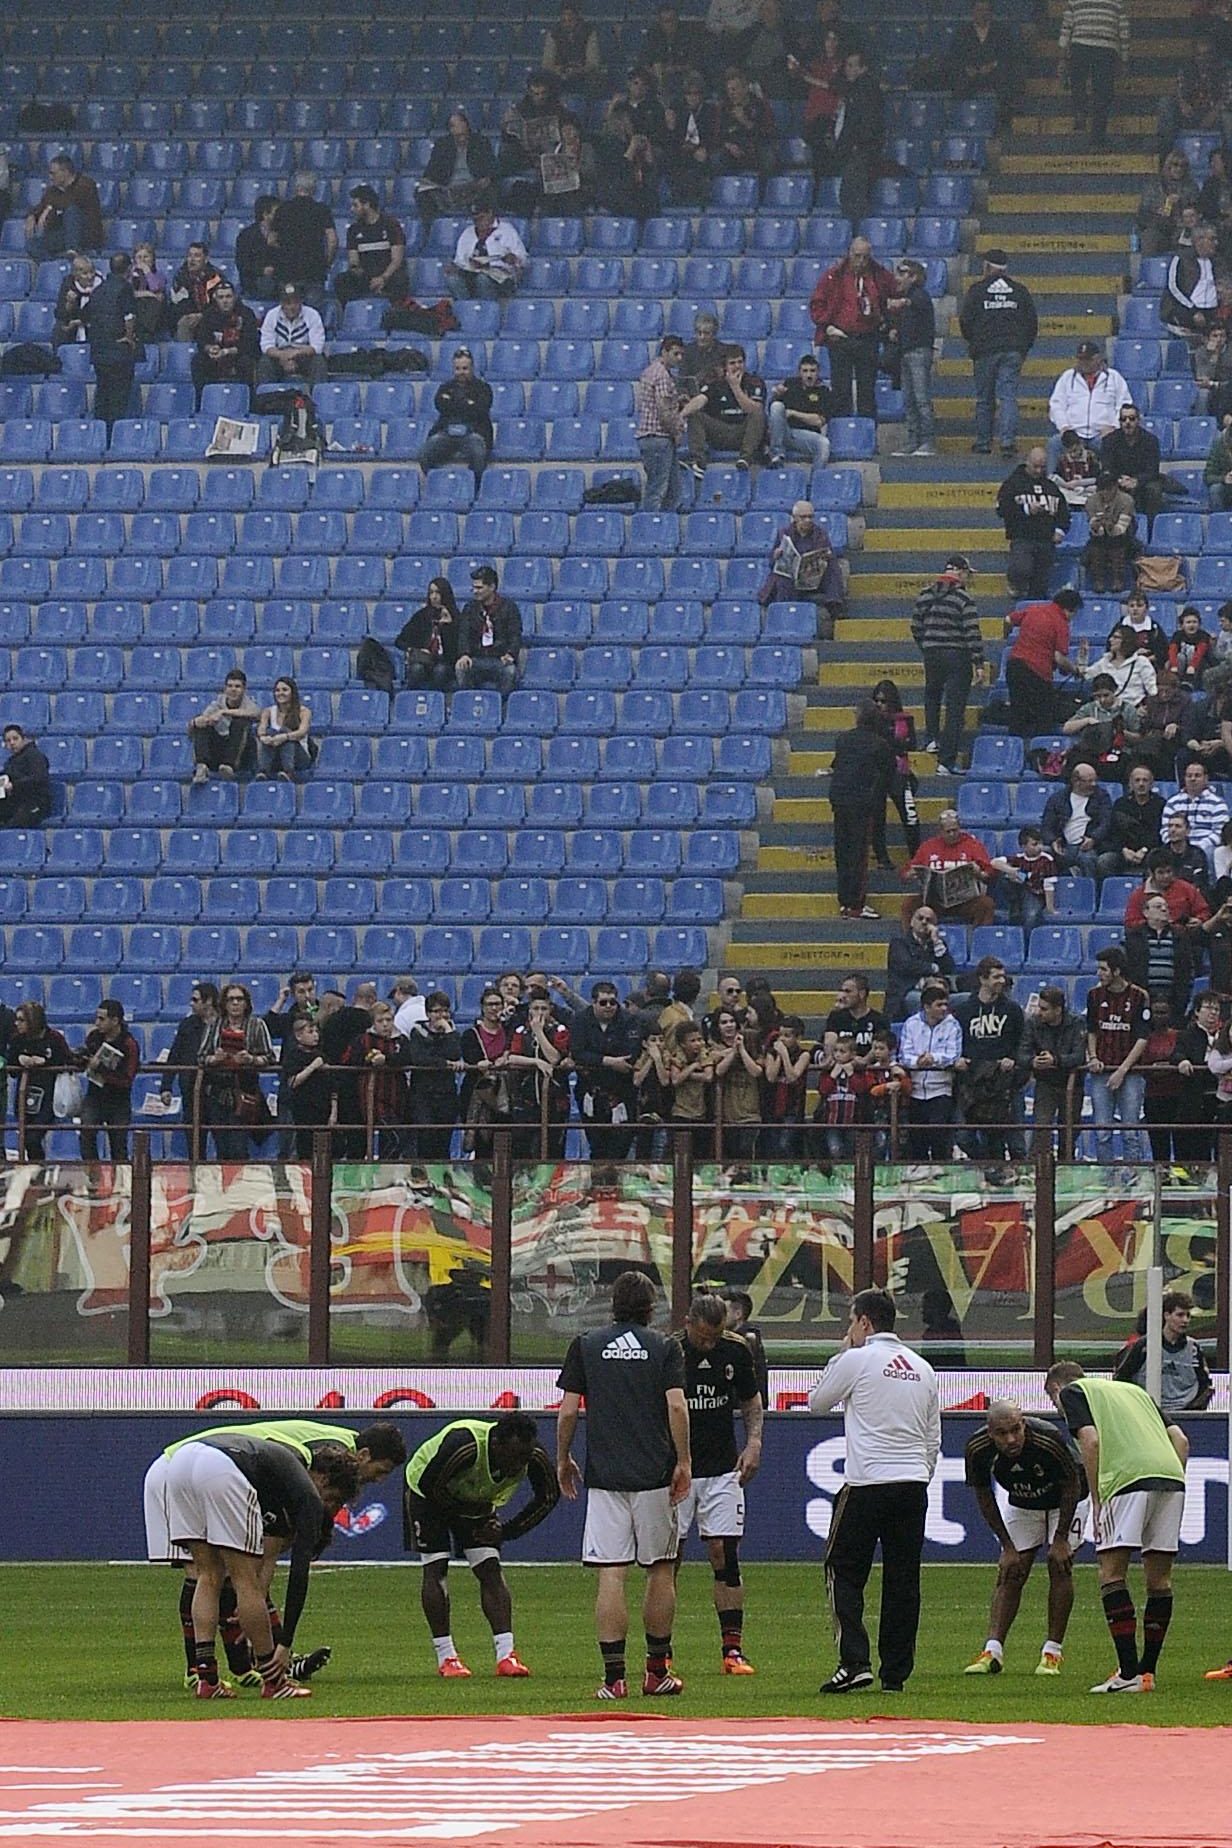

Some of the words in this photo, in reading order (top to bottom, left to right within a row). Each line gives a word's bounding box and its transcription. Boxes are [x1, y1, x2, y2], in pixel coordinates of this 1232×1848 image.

[601, 1345, 649, 1360] adidas
[883, 1367, 922, 1382] adidas
[695, 1383, 717, 1400] Fly
